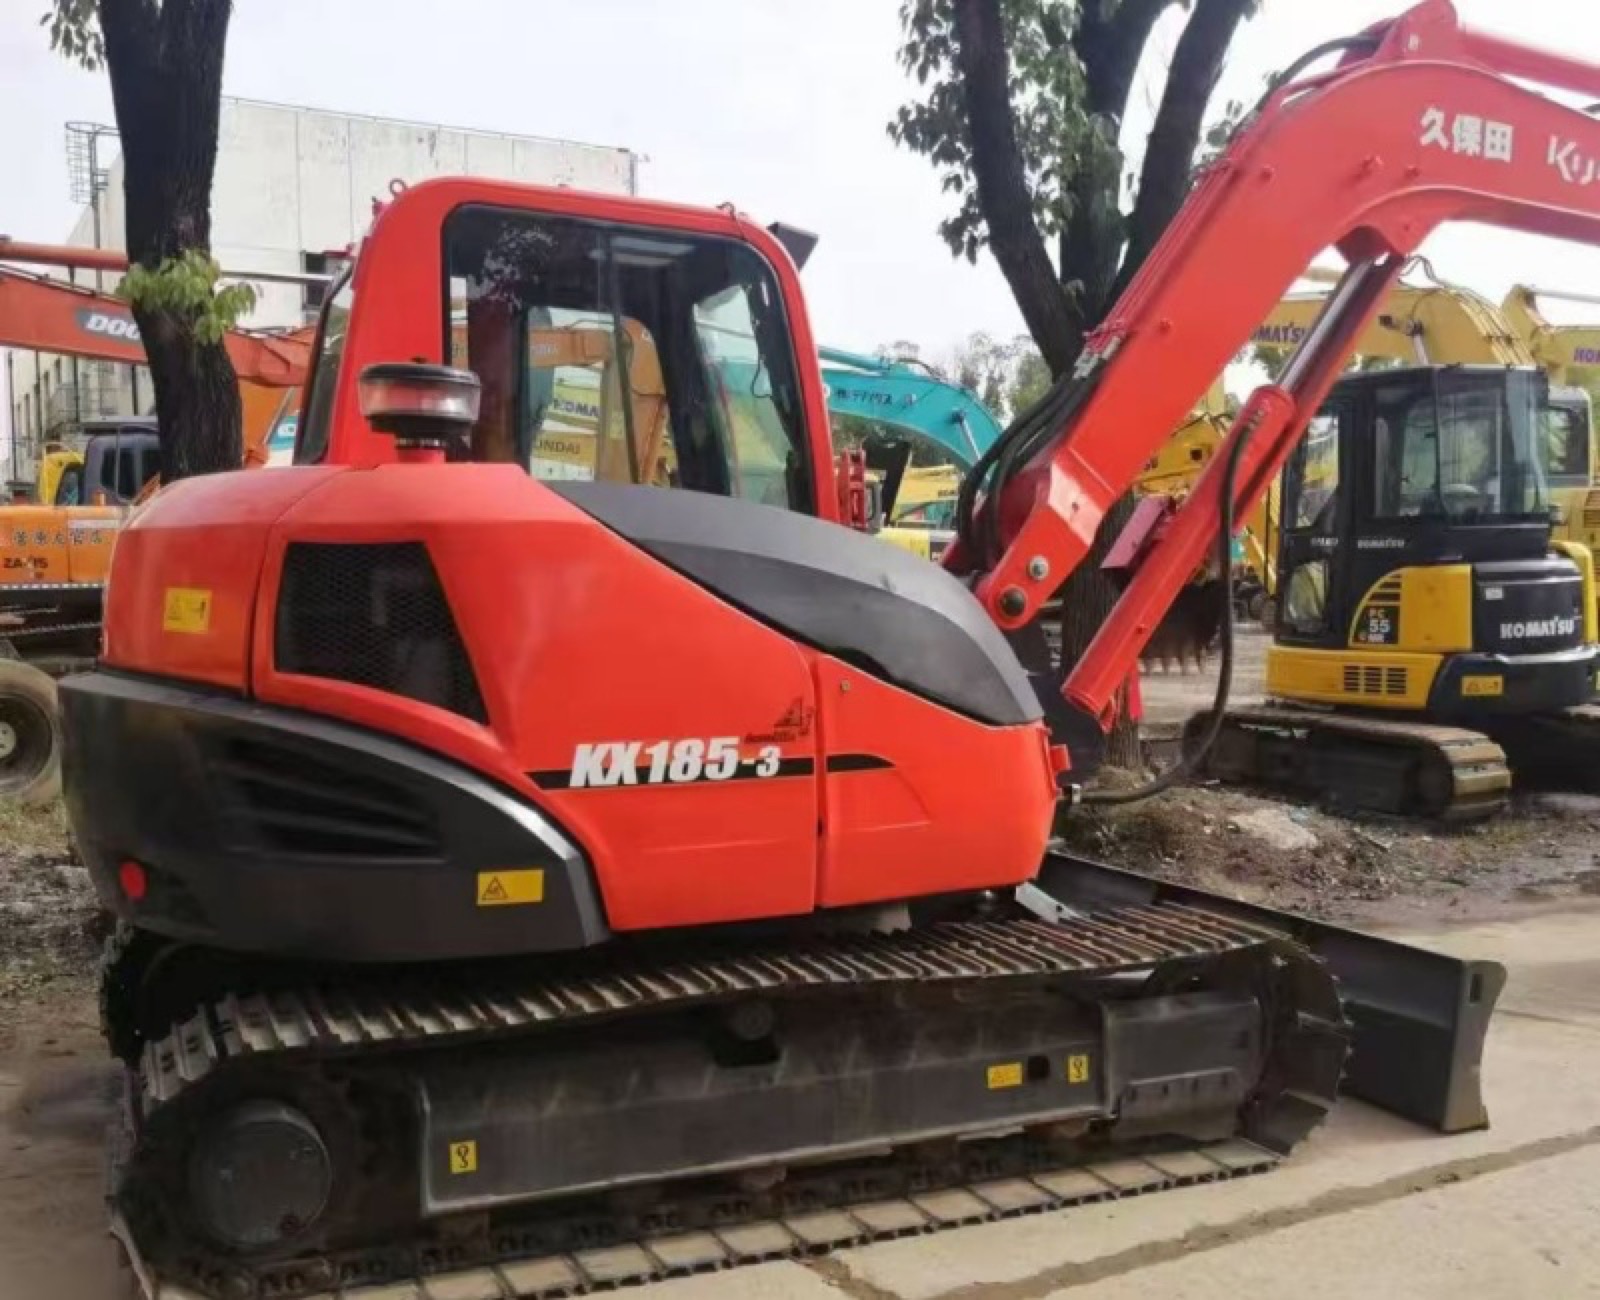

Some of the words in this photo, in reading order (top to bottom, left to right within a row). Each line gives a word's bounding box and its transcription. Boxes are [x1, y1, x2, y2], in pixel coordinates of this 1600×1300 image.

[1420, 107, 1513, 163] 久保田
[1547, 135, 1600, 186] Ku
[1573, 347, 1600, 363] KO
[1369, 619, 1391, 633] 55
[1500, 615, 1575, 639] KOMATSU
[569, 736, 782, 788] KX185-3
